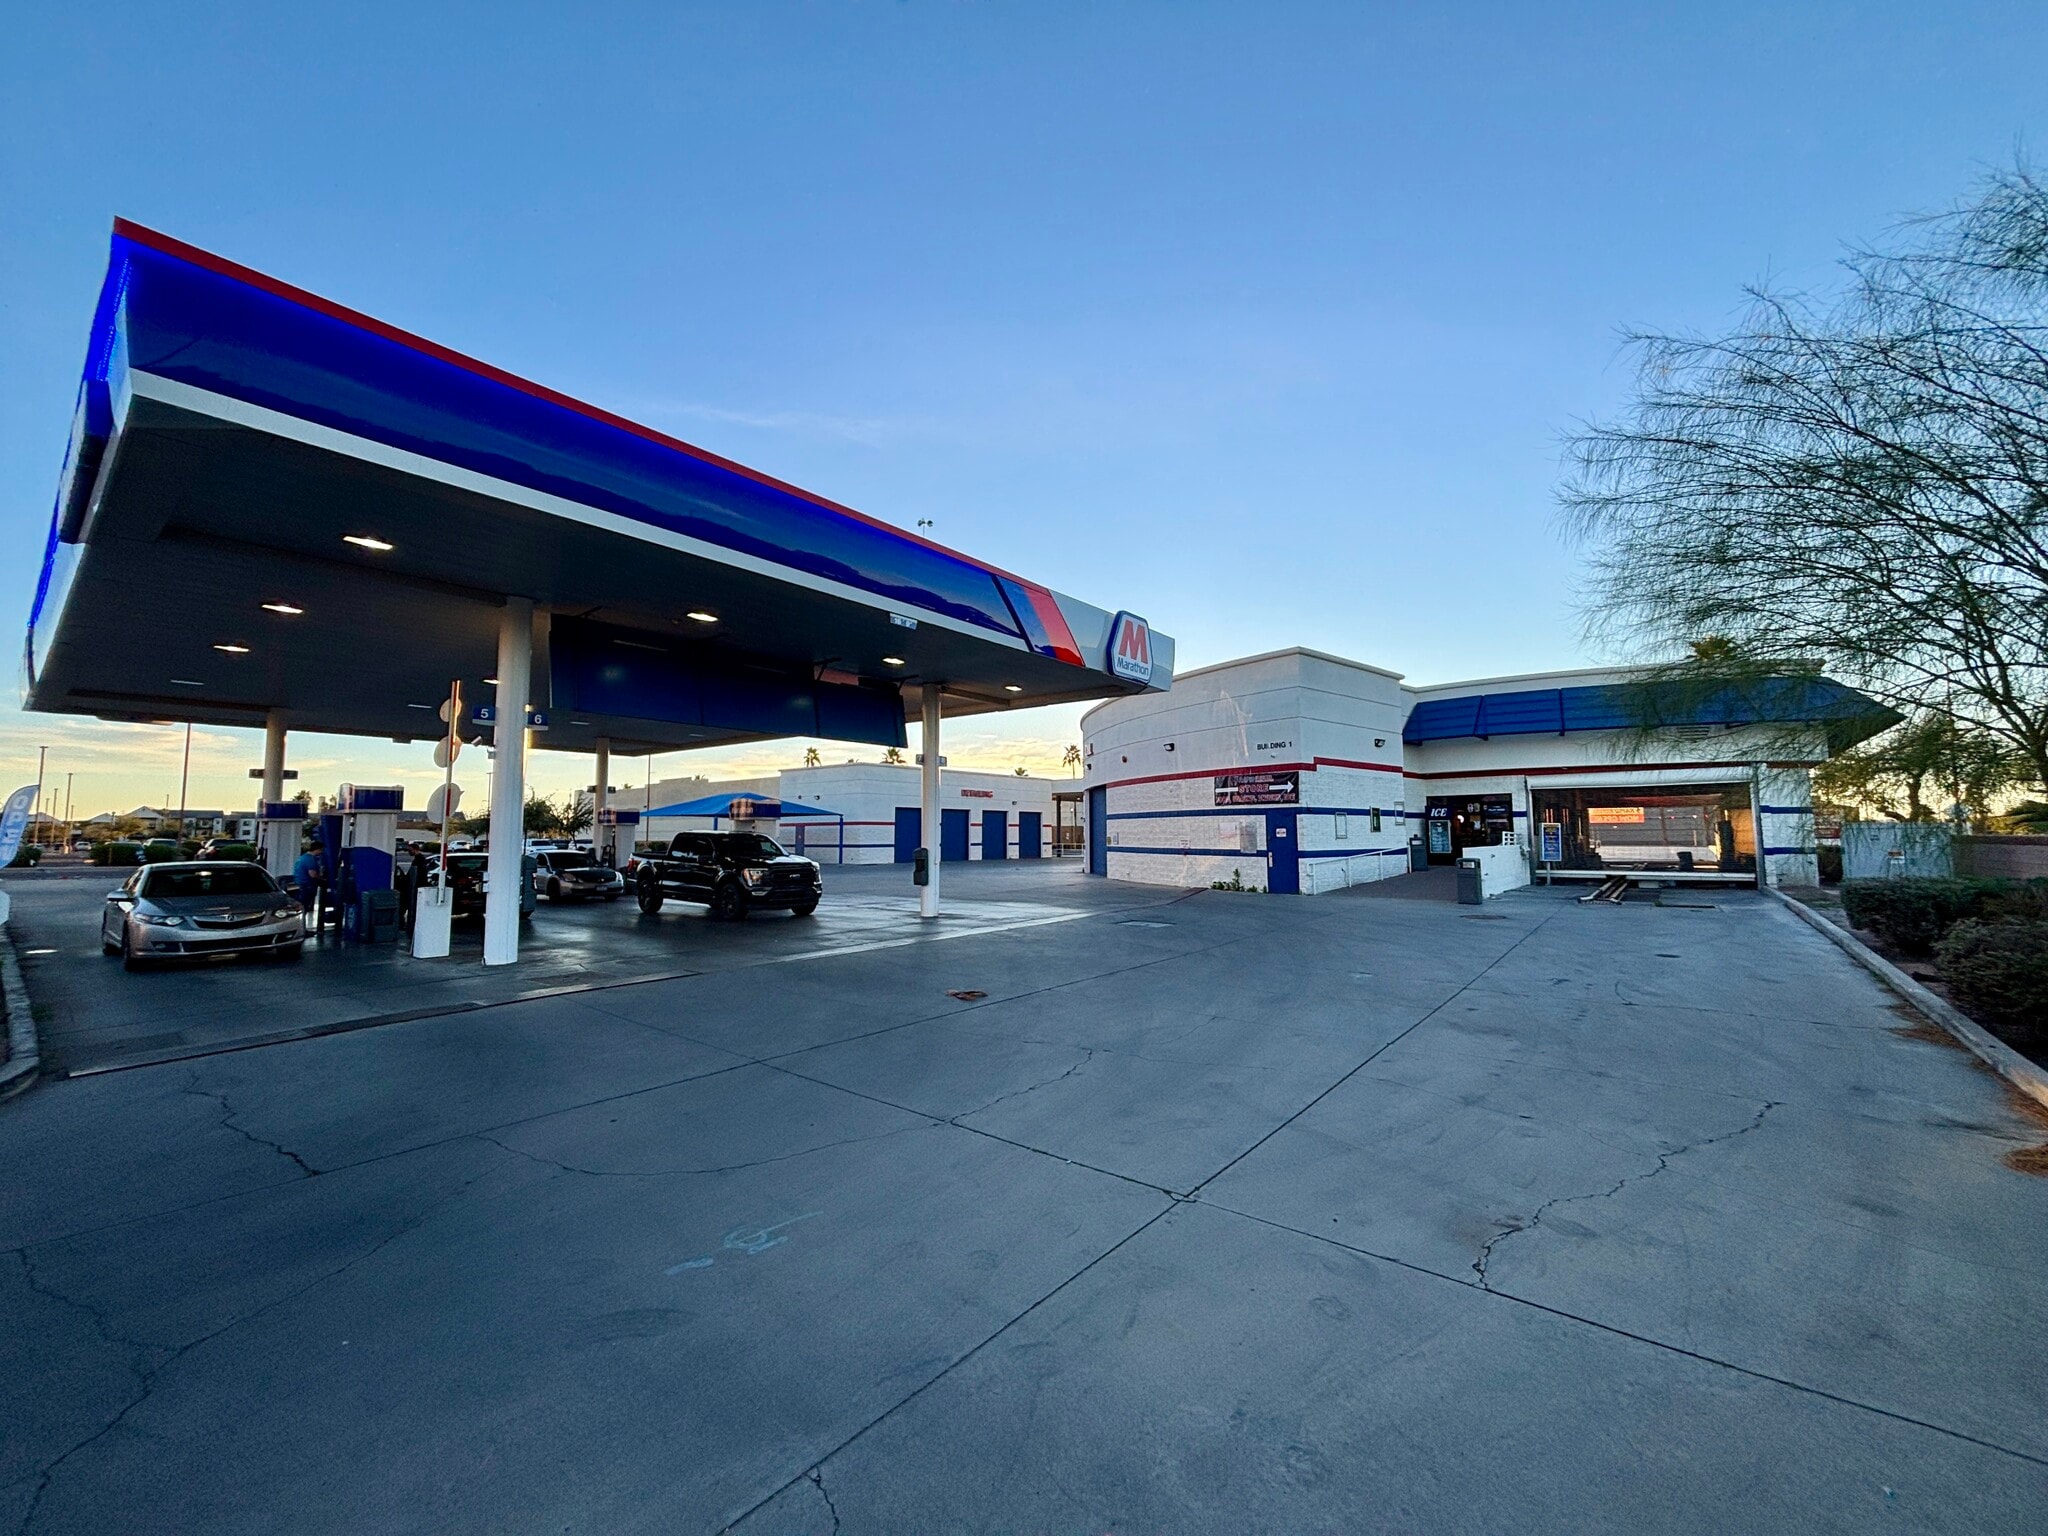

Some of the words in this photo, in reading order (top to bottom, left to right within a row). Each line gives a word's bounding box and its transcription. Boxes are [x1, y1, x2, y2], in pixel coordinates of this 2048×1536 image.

[1118, 619, 1149, 665] M
[1116, 656, 1149, 676] Marathon
[480, 708, 489, 719] 5
[533, 714, 542, 724] 6
[1256, 741, 1287, 750] BUIDING
[1238, 783, 1269, 793] STORE
[1430, 807, 1448, 817] ICE
